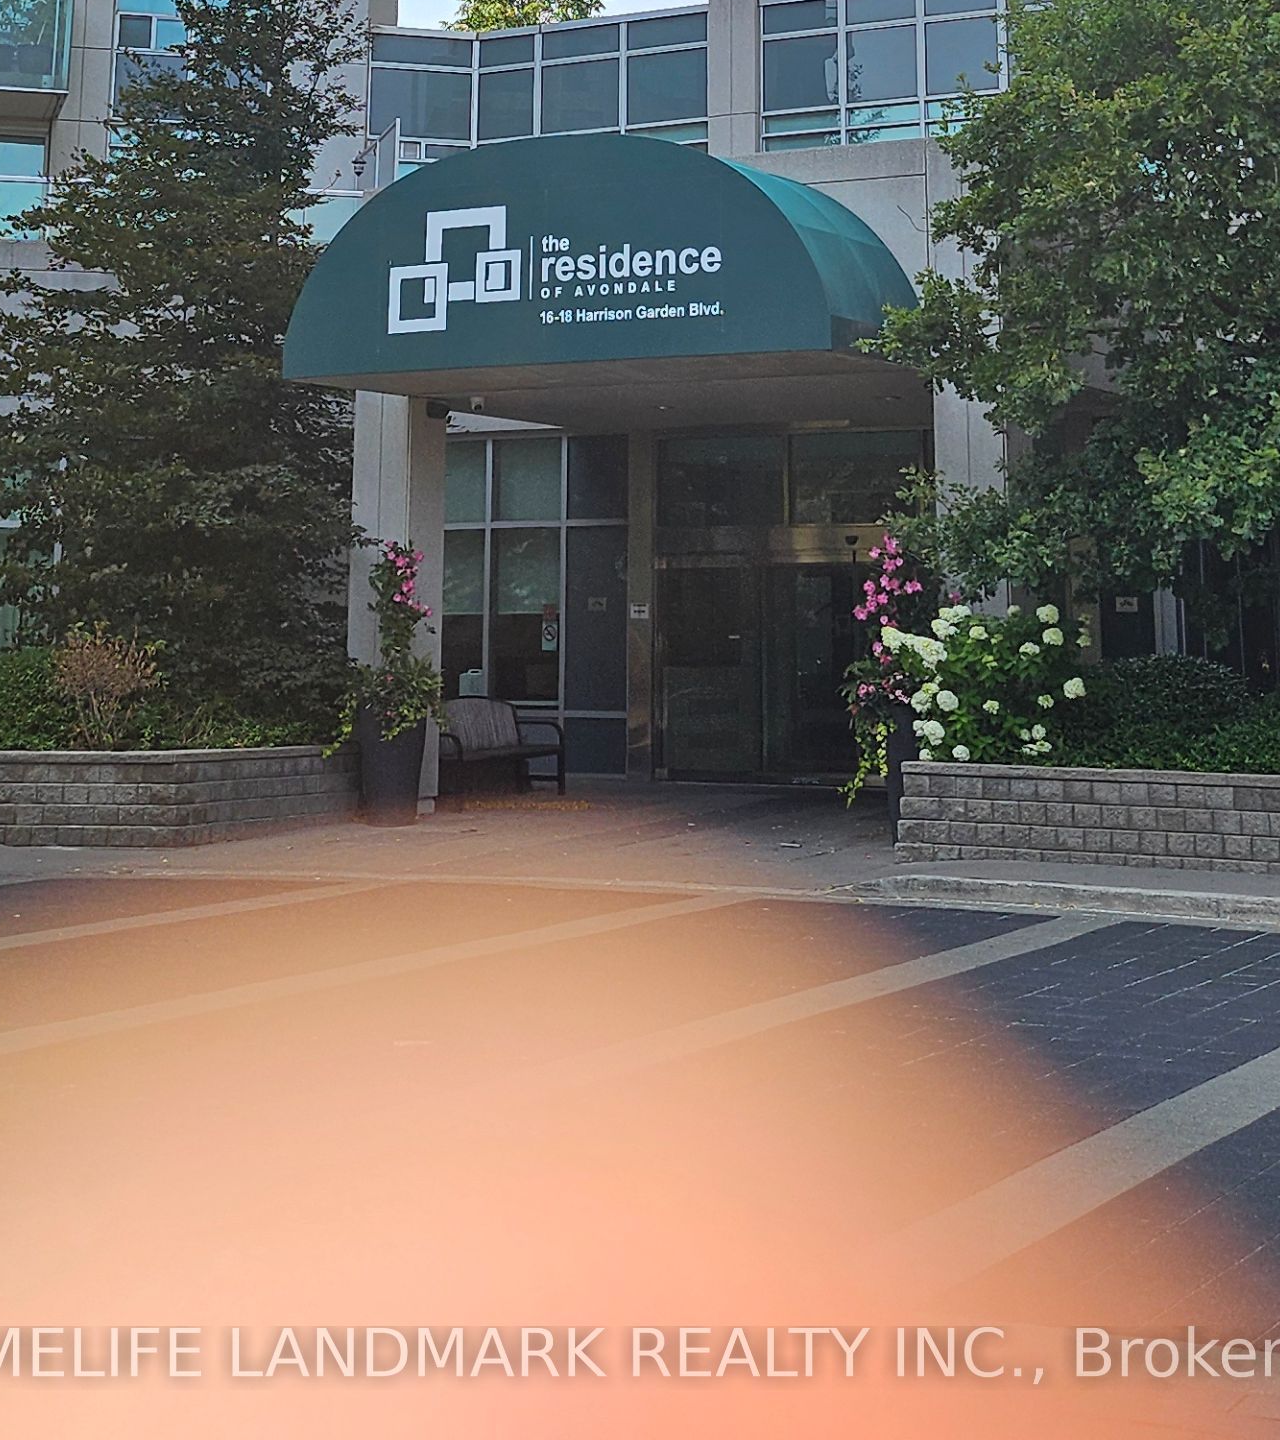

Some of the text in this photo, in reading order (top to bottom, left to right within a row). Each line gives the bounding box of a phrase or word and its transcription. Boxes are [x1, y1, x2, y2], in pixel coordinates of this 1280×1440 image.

[541, 234, 570, 253] the
[541, 243, 722, 283] residence
[540, 280, 677, 299] OF AVONDALE
[539, 301, 725, 325] 16-18 Harrison Garden Blvd.
